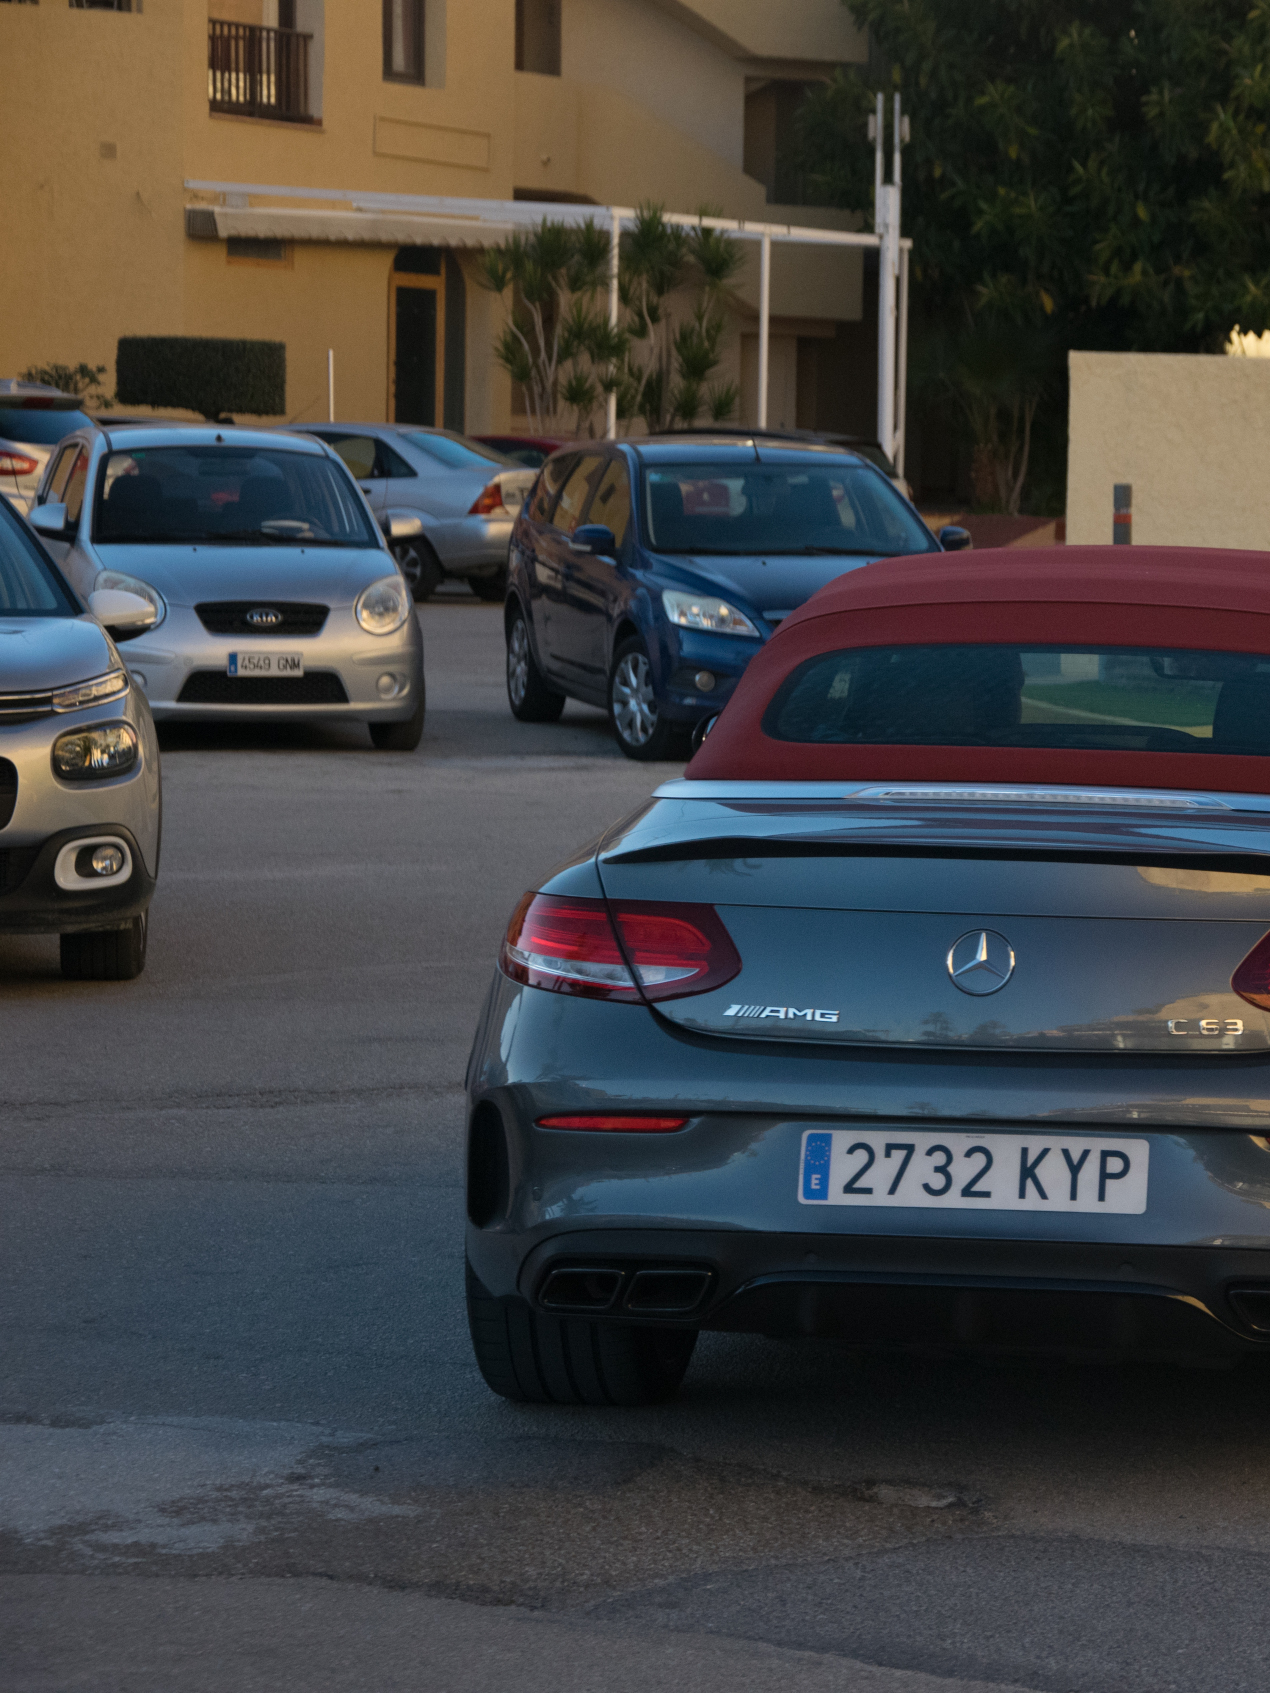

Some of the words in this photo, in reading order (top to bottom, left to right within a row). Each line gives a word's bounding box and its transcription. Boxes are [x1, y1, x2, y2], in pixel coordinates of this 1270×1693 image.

[252, 612, 276, 623] KIA
[241, 656, 271, 672] 4549
[277, 656, 301, 672] GNM
[1168, 1019, 1188, 1035] C
[1199, 1019, 1244, 1035] 63
[810, 1174, 821, 1190] E
[843, 1142, 993, 1198] 2732
[1018, 1147, 1131, 1202] KYP
